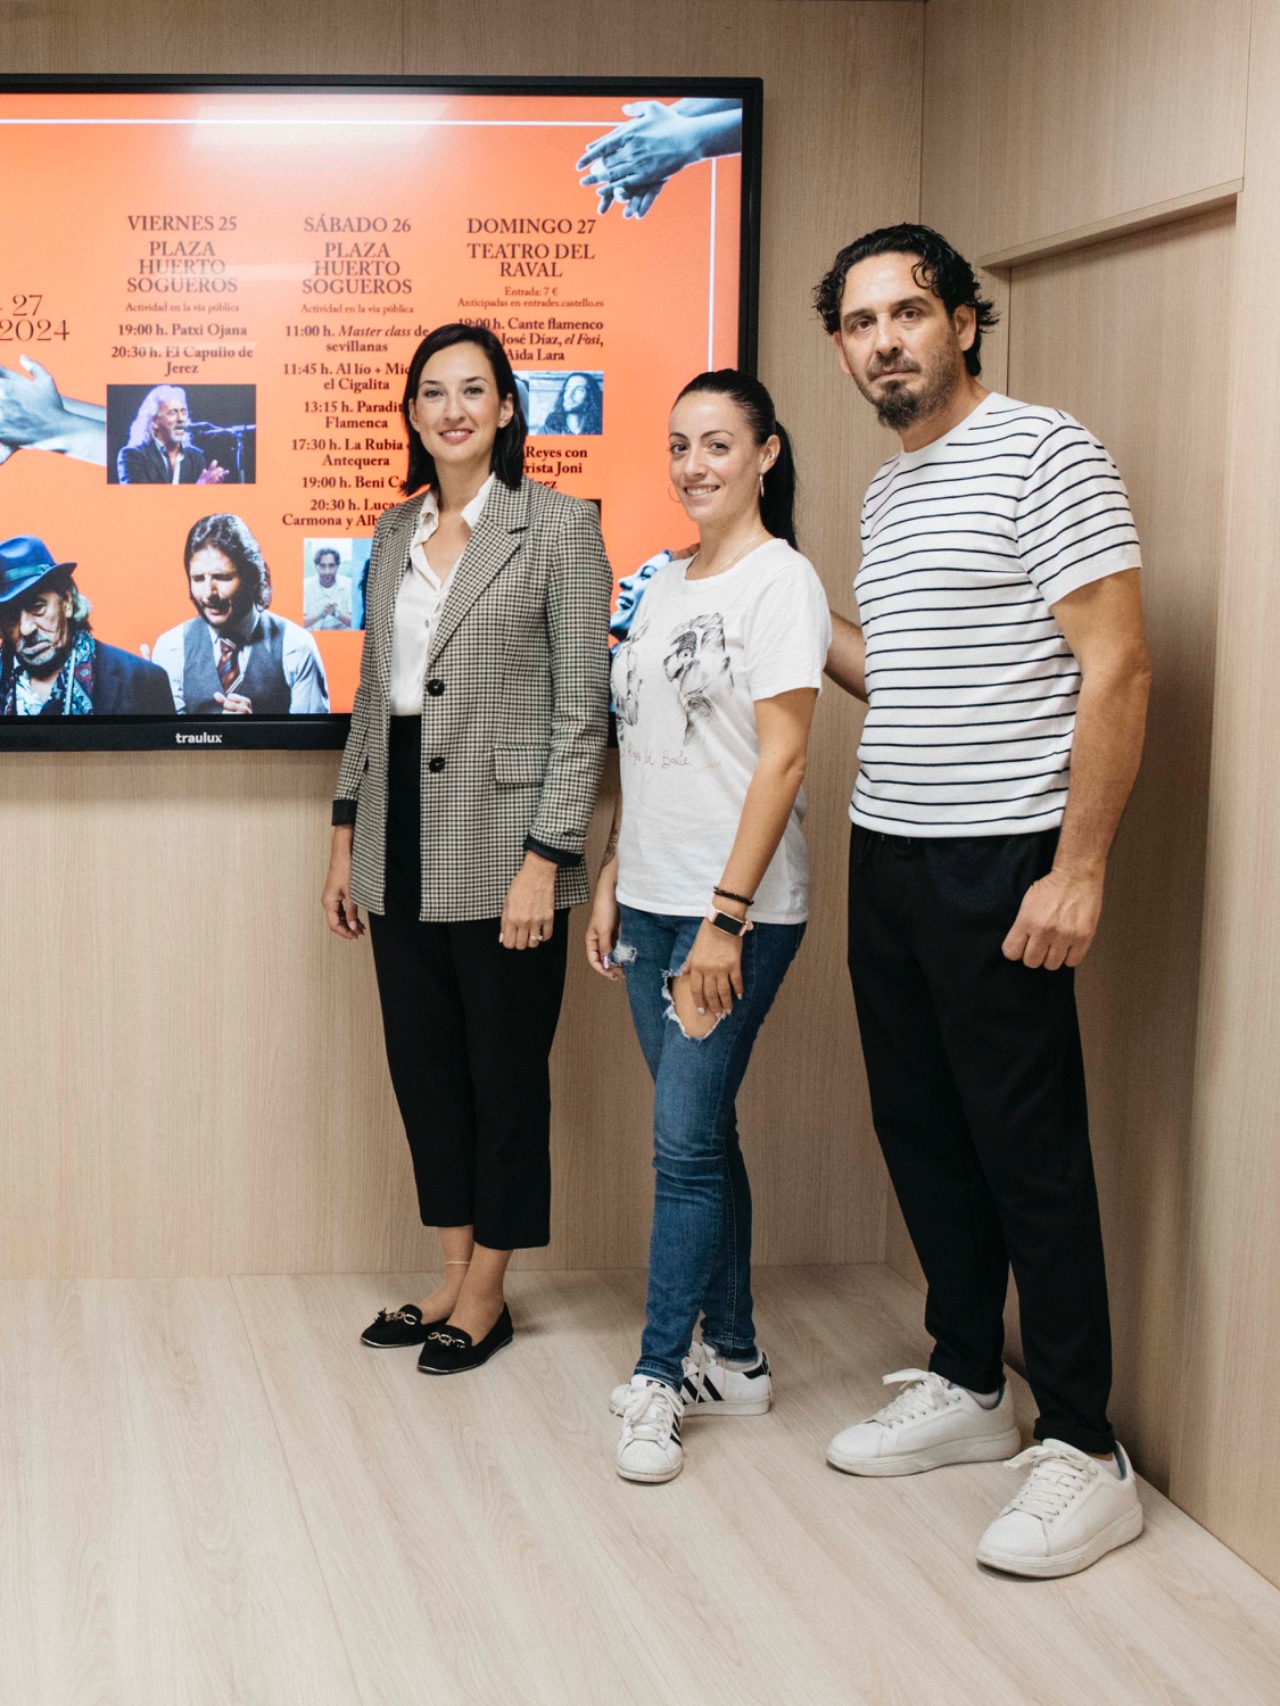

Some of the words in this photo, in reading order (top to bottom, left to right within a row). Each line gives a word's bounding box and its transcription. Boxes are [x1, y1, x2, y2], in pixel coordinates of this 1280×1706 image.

[127, 215, 214, 231] VIERNES
[218, 215, 238, 231] 25
[304, 213, 388, 232] SÁBADO
[392, 218, 412, 232] 26
[467, 218, 573, 234] DOMINGO
[577, 218, 596, 234] 27
[149, 240, 216, 257] PLAZA
[325, 242, 391, 258] PLAZA
[467, 243, 550, 259] TEATRO
[554, 243, 596, 259] DEL
[139, 259, 226, 275] HUERTO
[315, 260, 401, 276] HUERTO
[500, 261, 563, 277] RAVAL
[127, 277, 237, 293] SOGUEROS
[302, 279, 412, 294] SOGUEROS
[505, 287, 542, 296] Entrada:
[544, 288, 550, 296] 7
[551, 288, 558, 296] €
[12, 294, 43, 317] 27
[125, 303, 167, 312] Actividad
[183, 303, 191, 312] la
[300, 304, 342, 313] Actividad
[358, 304, 366, 313] la
[457, 299, 508, 309] Anticipadas
[118, 324, 153, 336] 19:00
[156, 324, 168, 336] h.
[171, 324, 204, 336] Patxi
[207, 323, 247, 339] Ojana
[285, 325, 320, 337] 11:00
[323, 325, 335, 337] h.
[338, 325, 382, 337] Master
[384, 325, 411, 337] class
[414, 325, 429, 337] de
[493, 318, 505, 330] h.
[508, 318, 545, 330] Cante
[548, 318, 604, 330] flamenco
[326, 340, 388, 352] sevillanas
[501, 333, 526, 347] José
[564, 333, 575, 345] el
[111, 346, 146, 358] 20:30
[149, 346, 162, 358] h.
[165, 346, 180, 358] El
[183, 346, 235, 361] Capullo
[238, 346, 254, 358] de
[537, 348, 565, 361] Lara
[164, 361, 199, 377] Jerez
[283, 363, 317, 375] 11:45
[320, 363, 333, 375] h.
[336, 363, 351, 375] Al
[324, 378, 335, 390] el
[338, 378, 390, 393] Cigalita
[304, 401, 338, 413] 13:15
[341, 401, 353, 413] h.
[357, 401, 404, 413] Paradit
[325, 416, 388, 429] Flamenca
[292, 438, 326, 450] 17:30
[329, 438, 341, 450] h.
[345, 438, 362, 450] La
[365, 438, 403, 450] Rubia
[525, 446, 562, 462] Reyes
[565, 449, 588, 458] con
[322, 454, 390, 470] Antequera
[554, 462, 583, 477] Joni
[302, 476, 336, 488] 19:00
[339, 476, 352, 488] h.
[355, 476, 385, 488] Beni
[310, 499, 345, 511] 20:30
[348, 499, 361, 511] h.
[282, 514, 342, 526] Carmona
[346, 518, 353, 530] y
[175, 732, 222, 744] traulux
